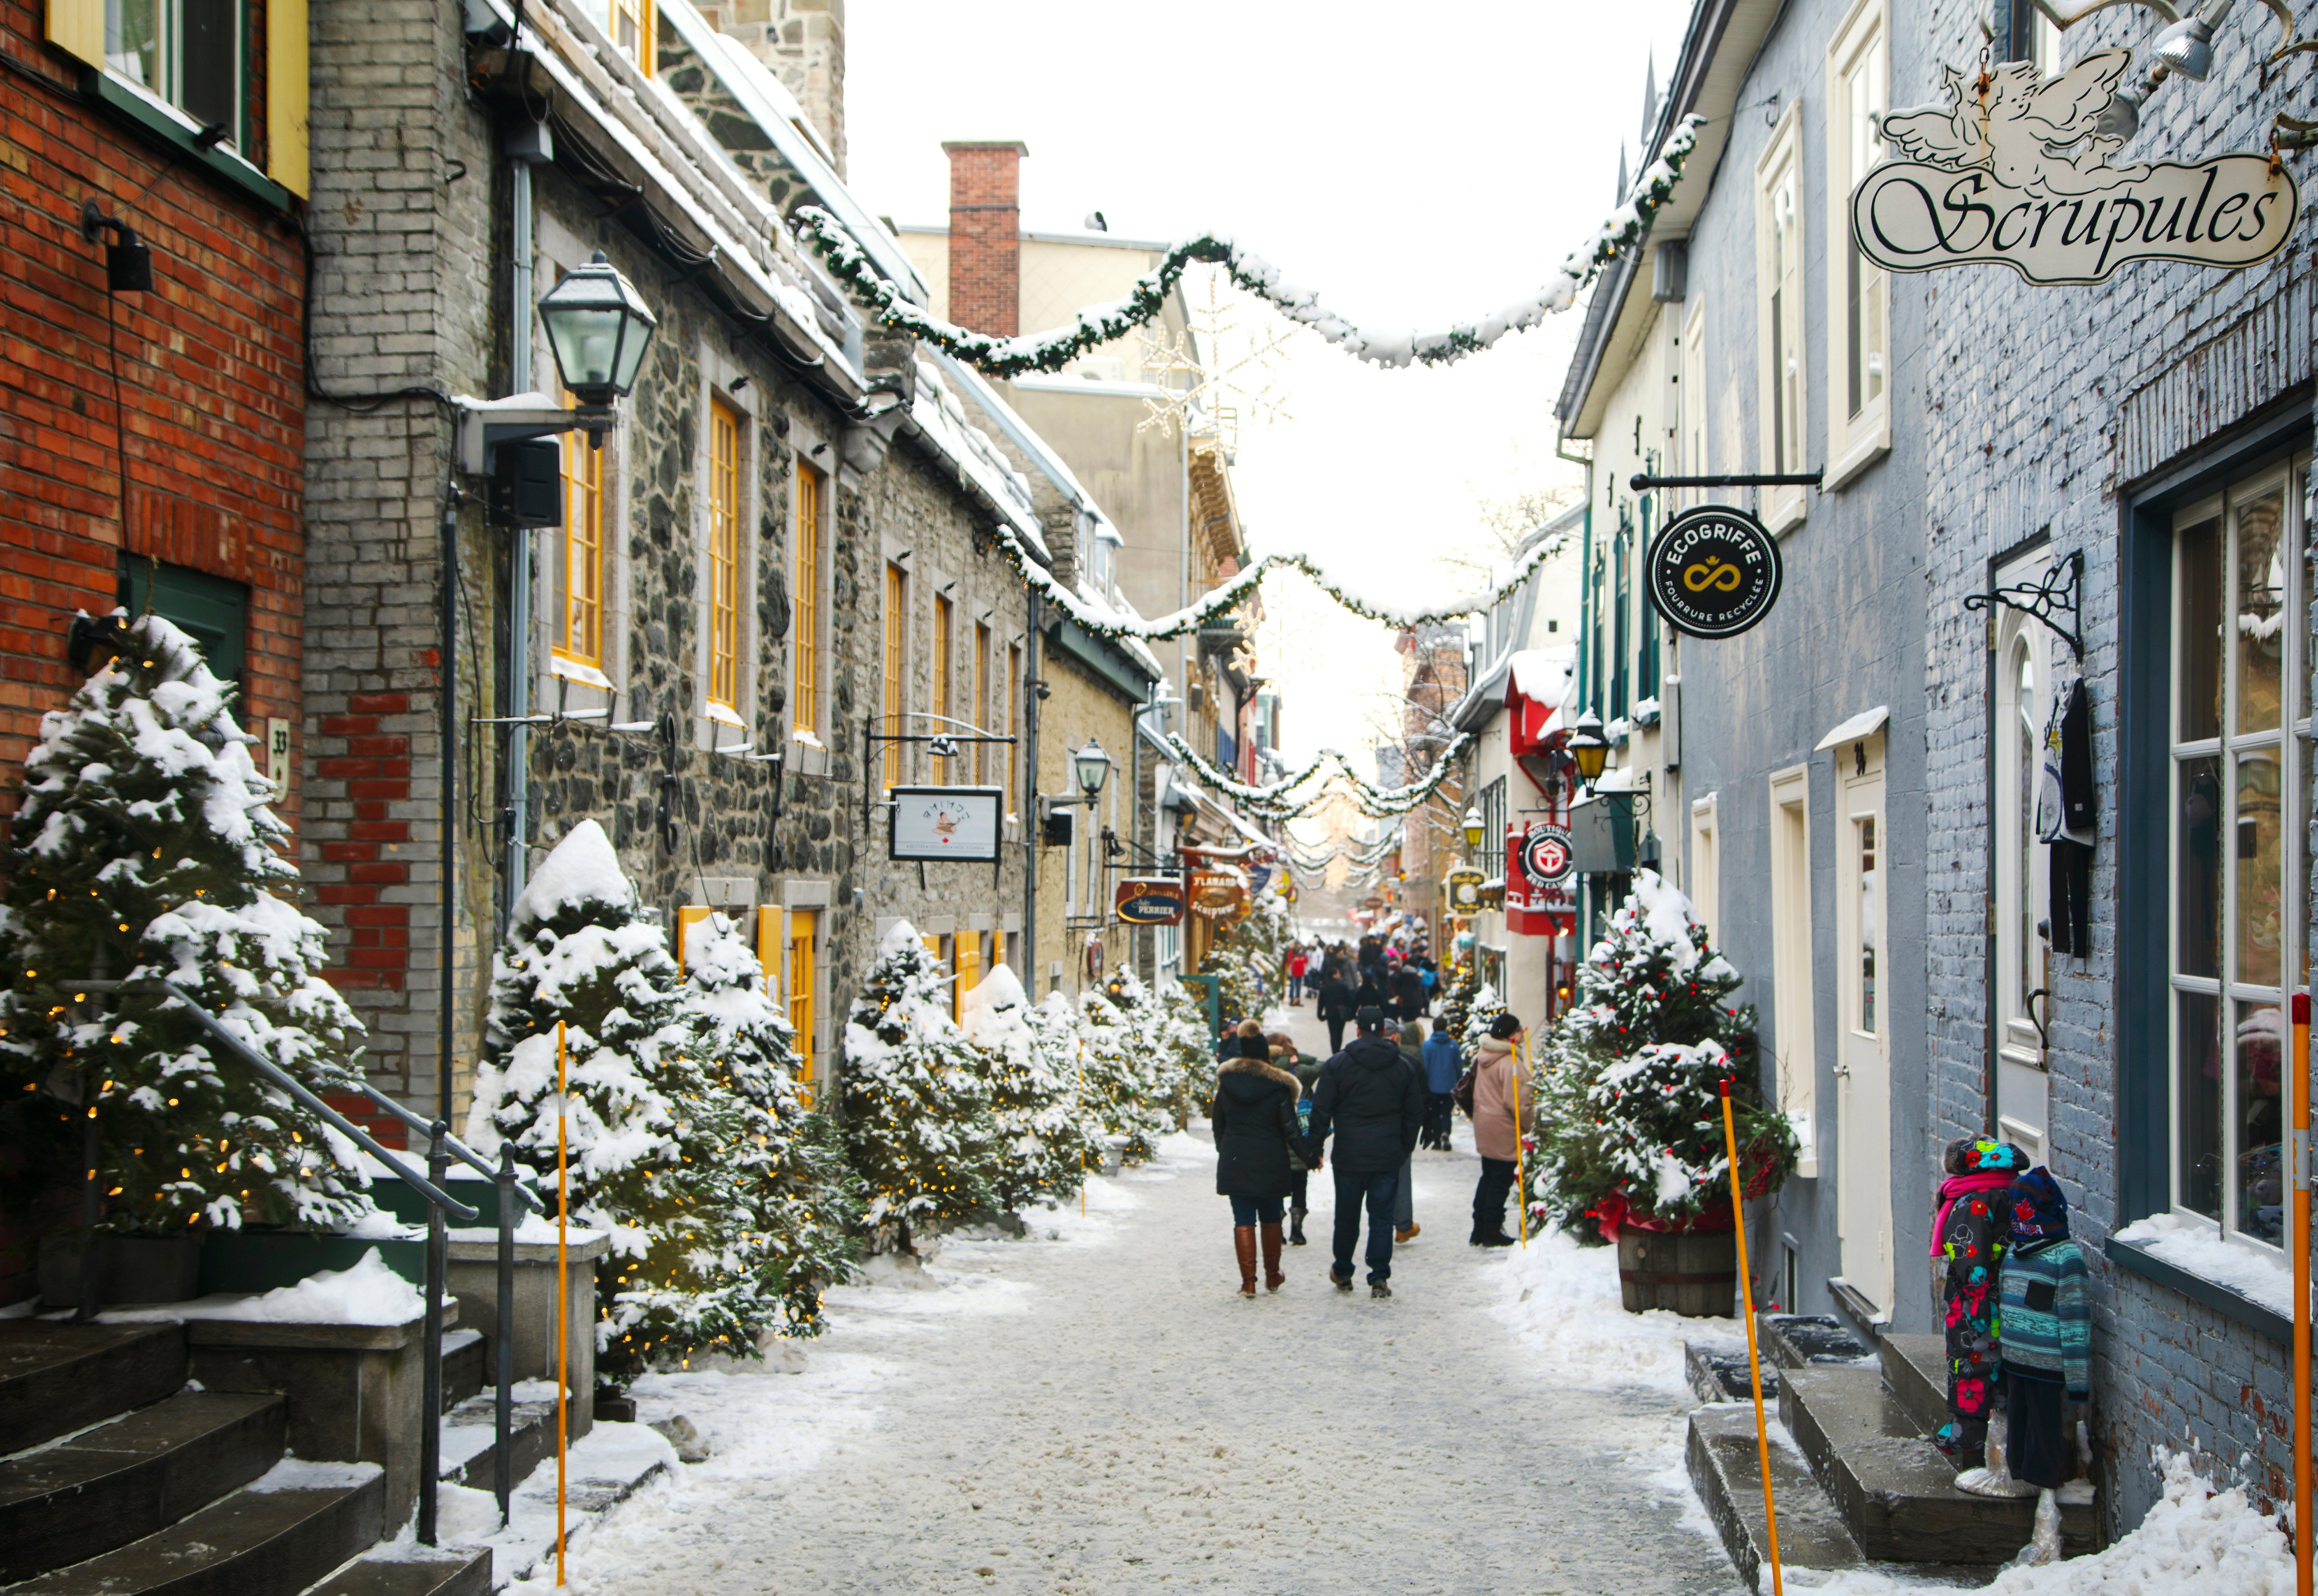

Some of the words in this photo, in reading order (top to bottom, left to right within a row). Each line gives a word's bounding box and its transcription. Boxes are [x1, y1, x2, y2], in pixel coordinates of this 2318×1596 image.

[1871, 165, 2279, 275] Scrupules
[1666, 523, 1762, 565] ECOGRIFFE
[1665, 580, 1713, 623] FOURRURE
[1719, 578, 1764, 622] RECYCLÉE
[1528, 824, 1572, 840] BOUTIQUE
[1193, 877, 1237, 887] FLAMAND
[1138, 905, 1176, 919] PERRIER
[2012, 1219, 2044, 1236] CANADA
